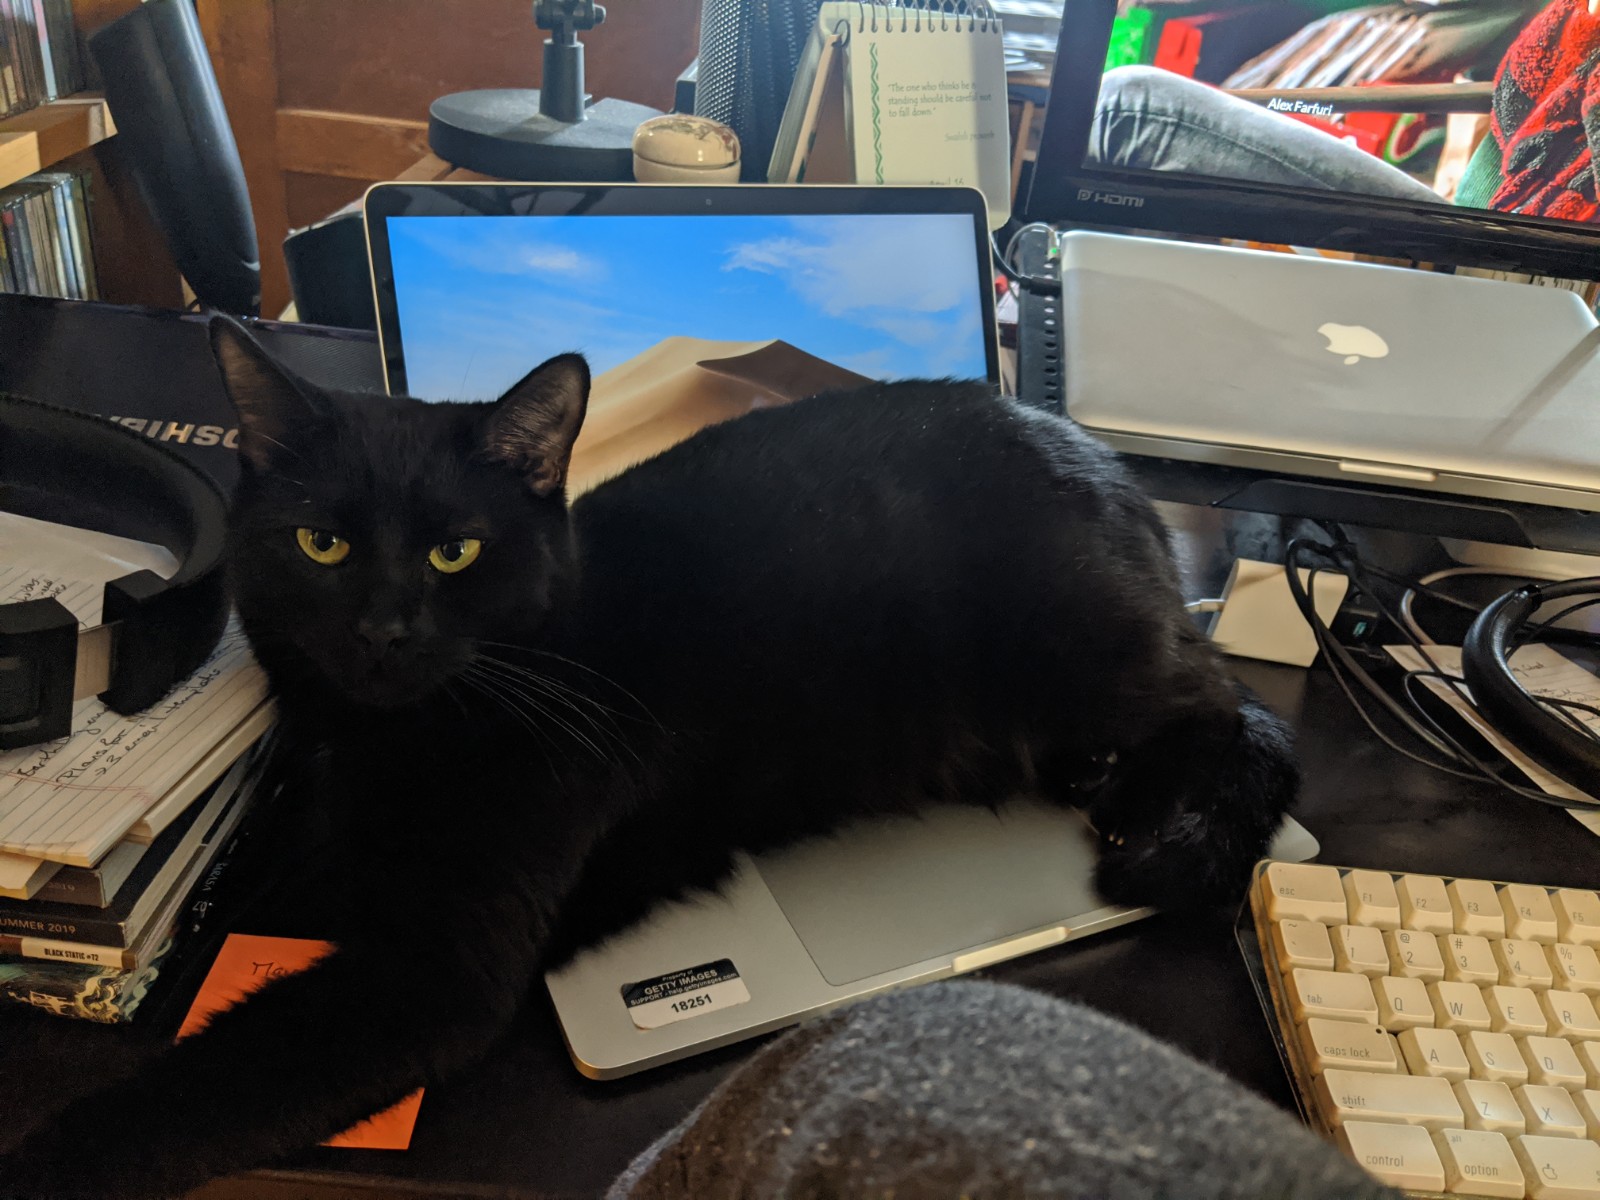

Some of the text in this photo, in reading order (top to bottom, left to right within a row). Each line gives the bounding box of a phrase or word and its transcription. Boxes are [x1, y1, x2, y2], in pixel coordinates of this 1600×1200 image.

[906, 84, 920, 92] one
[922, 81, 937, 91] who
[939, 81, 960, 90] thinks
[888, 96, 918, 106] standing
[920, 93, 943, 103] should
[1267, 97, 1334, 116] Alex Farfuri
[888, 109, 897, 118] to
[898, 106, 910, 117] fall
[1094, 192, 1145, 208] HDMI
[1279, 887, 1584, 922] esc F1 F2 F3 F4 F5
[48, 923, 76, 934] 2019
[44, 948, 64, 958] BLACK
[65, 950, 86, 960] STATIC
[1406, 951, 1413, 963] 2
[1460, 955, 1468, 968] 3
[1514, 960, 1522, 972] 4
[1568, 964, 1576, 977] 5
[644, 970, 718, 996] GETTY IMAGES
[662, 972, 686, 982] Property
[630, 992, 664, 1006] SUPPORT
[671, 993, 713, 1013] 18251
[1307, 994, 1572, 1025] tab Q W E R
[1324, 1045, 1370, 1058] caps lock
[1430, 1048, 1554, 1071] A S D
[1342, 1095, 1366, 1106] shift
[1481, 1101, 1554, 1121] Z X
[1366, 1155, 1498, 1176] control option
